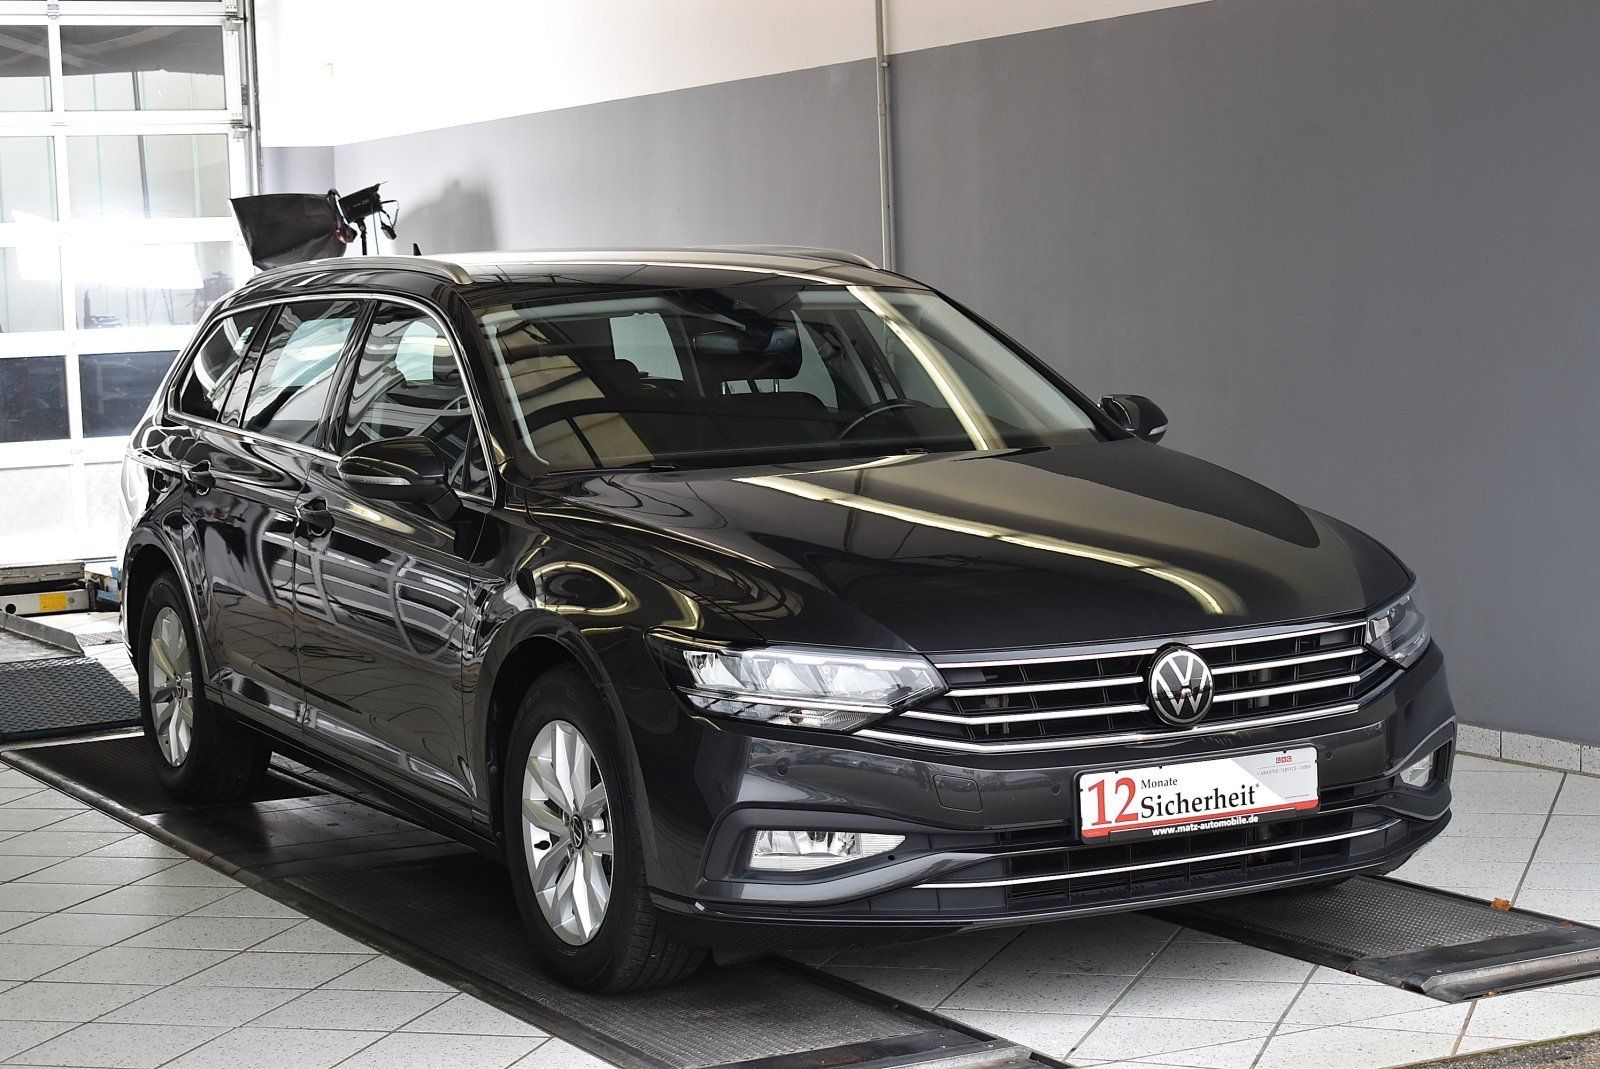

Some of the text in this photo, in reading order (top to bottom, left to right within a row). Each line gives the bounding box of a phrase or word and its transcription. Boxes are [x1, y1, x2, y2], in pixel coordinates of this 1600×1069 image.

[1140, 777, 1178, 790] Monate
[1087, 777, 1139, 827] 12
[1151, 814, 1260, 837] www.matz-automobile.de
